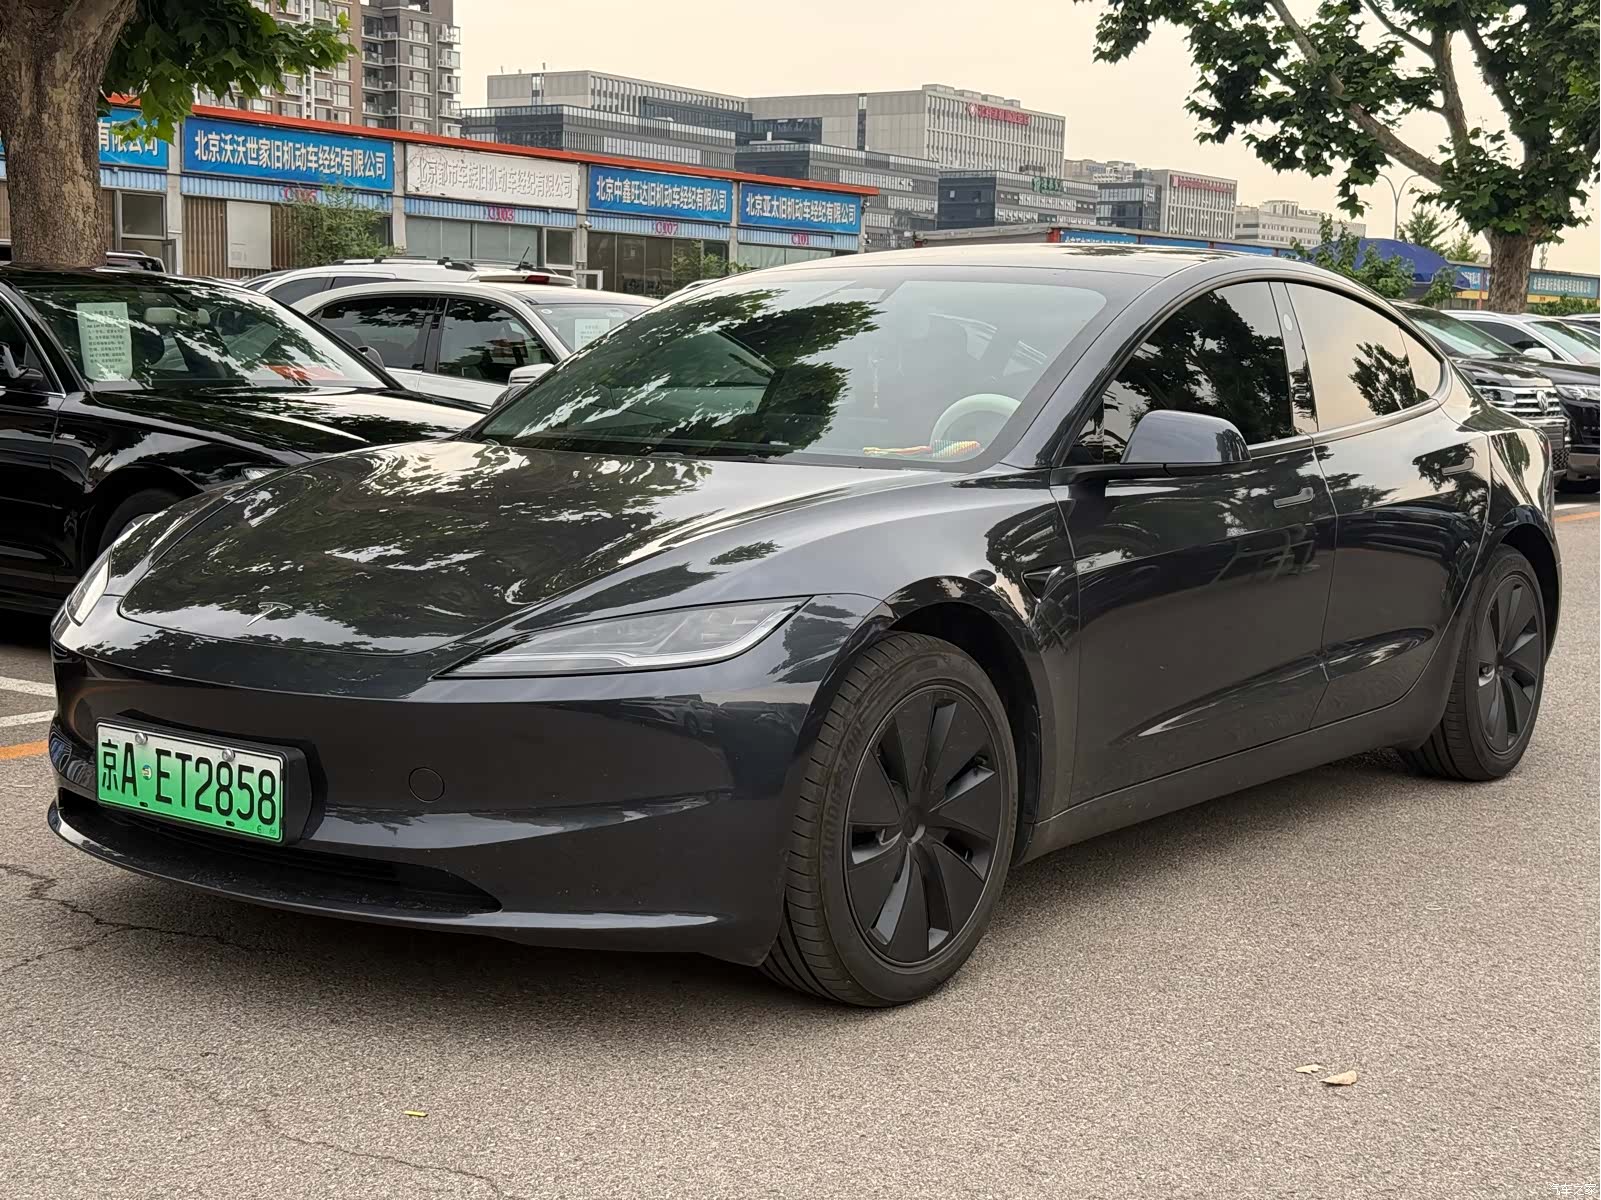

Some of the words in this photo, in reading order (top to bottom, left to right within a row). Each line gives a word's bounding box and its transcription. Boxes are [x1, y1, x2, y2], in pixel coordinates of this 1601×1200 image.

[194, 129, 386, 180] 北京沃沃世家旧机动车经纪有限公司
[417, 156, 573, 199] 北京都市车族旧机动车经纪有限公司
[595, 175, 727, 213] 北京中鑫旺达旧机动车经纪有限公司
[745, 192, 856, 225] 北京亚太旧机动车经纪有限公司
